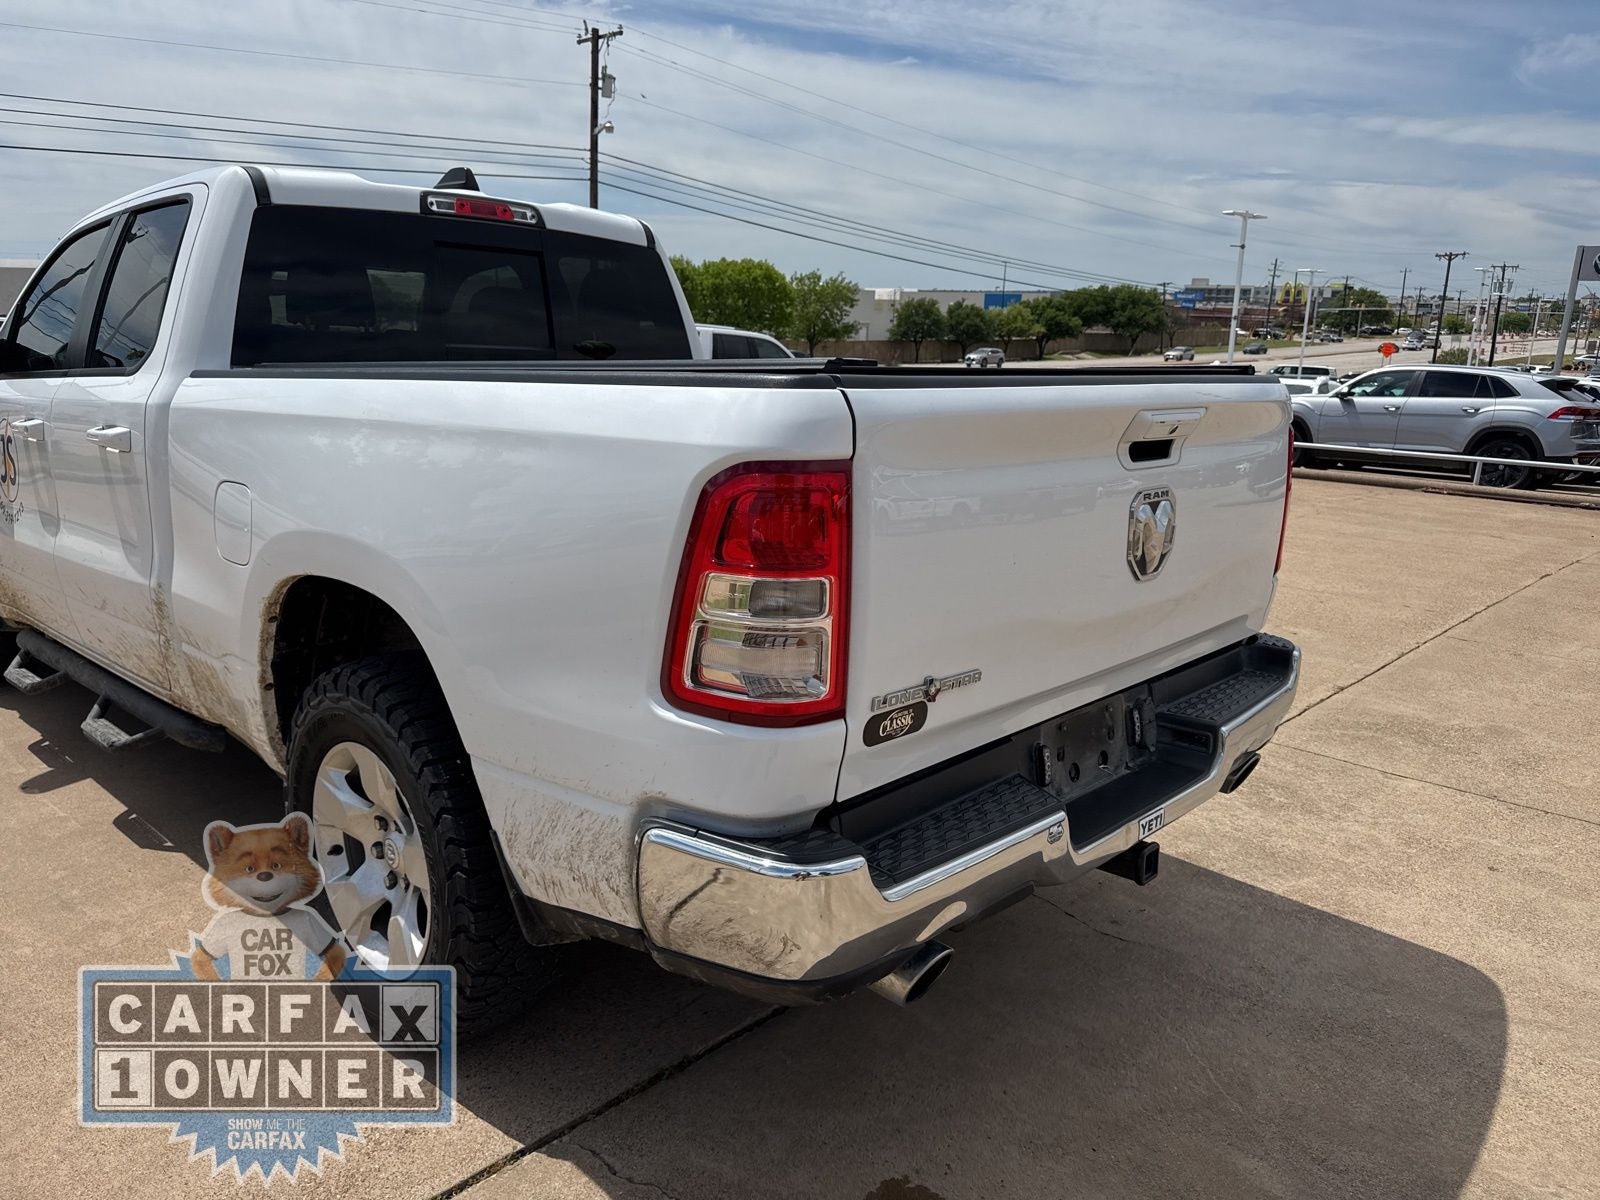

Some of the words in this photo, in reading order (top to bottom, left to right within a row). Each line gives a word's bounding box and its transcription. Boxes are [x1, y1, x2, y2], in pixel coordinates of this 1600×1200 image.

[1143, 490, 1170, 501] RAM
[871, 684, 927, 712] LONE
[939, 669, 982, 692] STAR
[879, 712, 915, 737] CLASSIC
[1140, 812, 1164, 836] YETI
